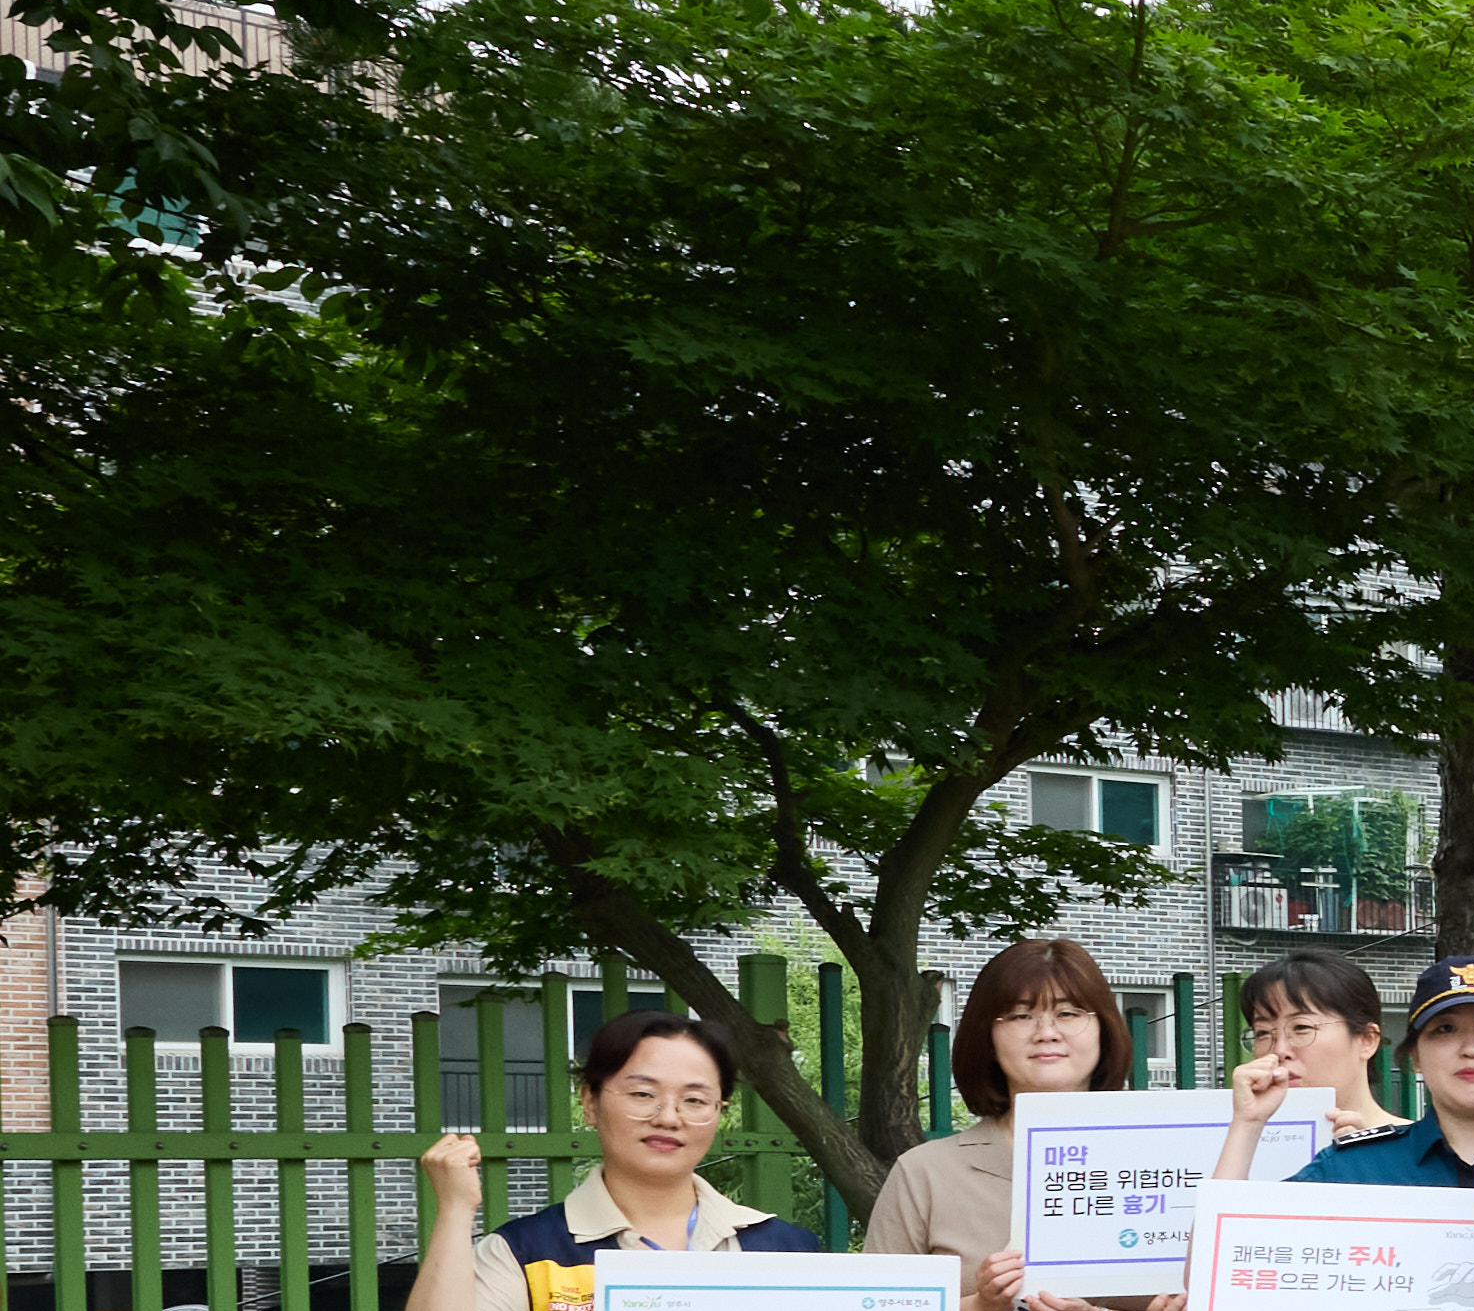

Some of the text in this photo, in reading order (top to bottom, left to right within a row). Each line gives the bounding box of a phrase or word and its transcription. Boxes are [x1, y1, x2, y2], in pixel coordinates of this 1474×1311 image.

[1044, 1146, 1088, 1166] 마약
[1044, 1168, 1203, 1191] 생명을 위협하는
[1044, 1194, 1166, 1217] 또 다른 흉기
[1232, 1245, 1401, 1268] 쾌락을 위한 주사,
[1230, 1269, 1414, 1293] 죽음으로 가는 사약
